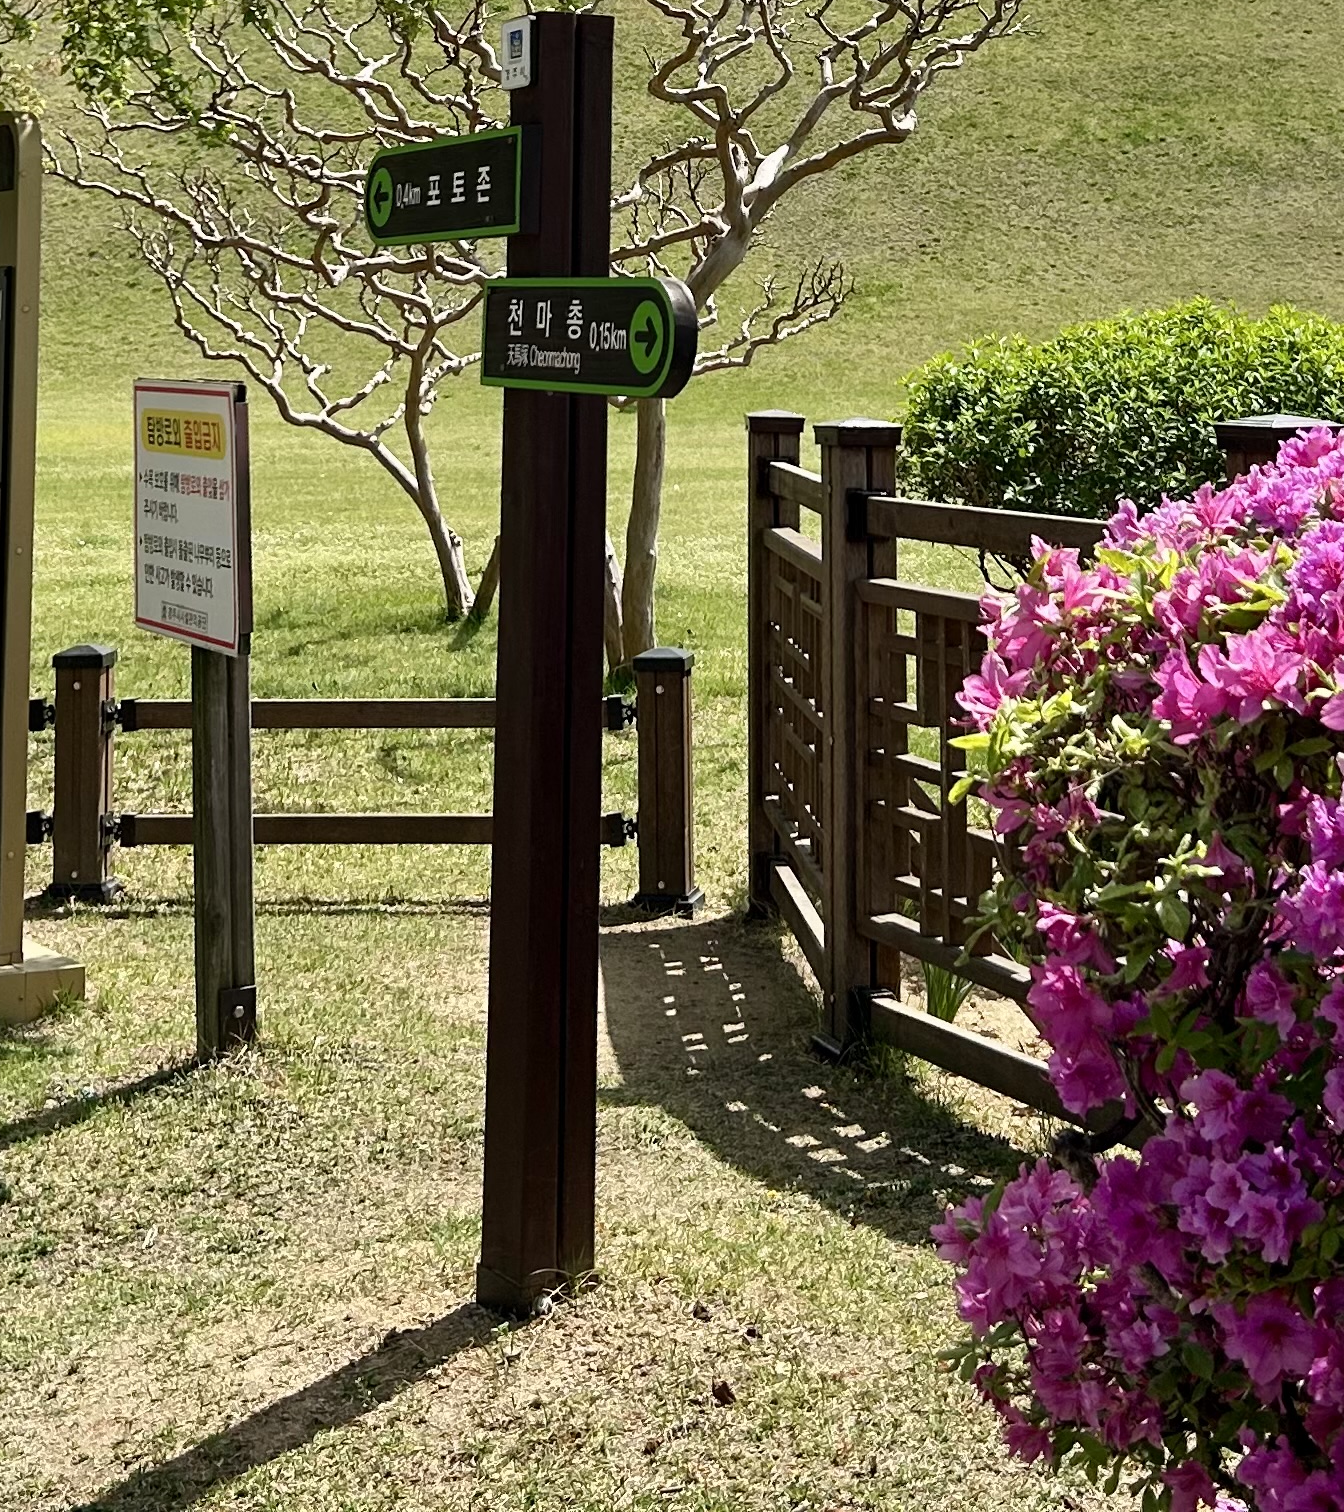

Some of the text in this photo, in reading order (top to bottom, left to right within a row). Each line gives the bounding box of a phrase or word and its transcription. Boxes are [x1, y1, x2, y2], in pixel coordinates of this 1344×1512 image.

[396, 182, 421, 209] 0.4km
[589, 321, 627, 352] 0.15km
[184, 419, 221, 453] 출입금지
